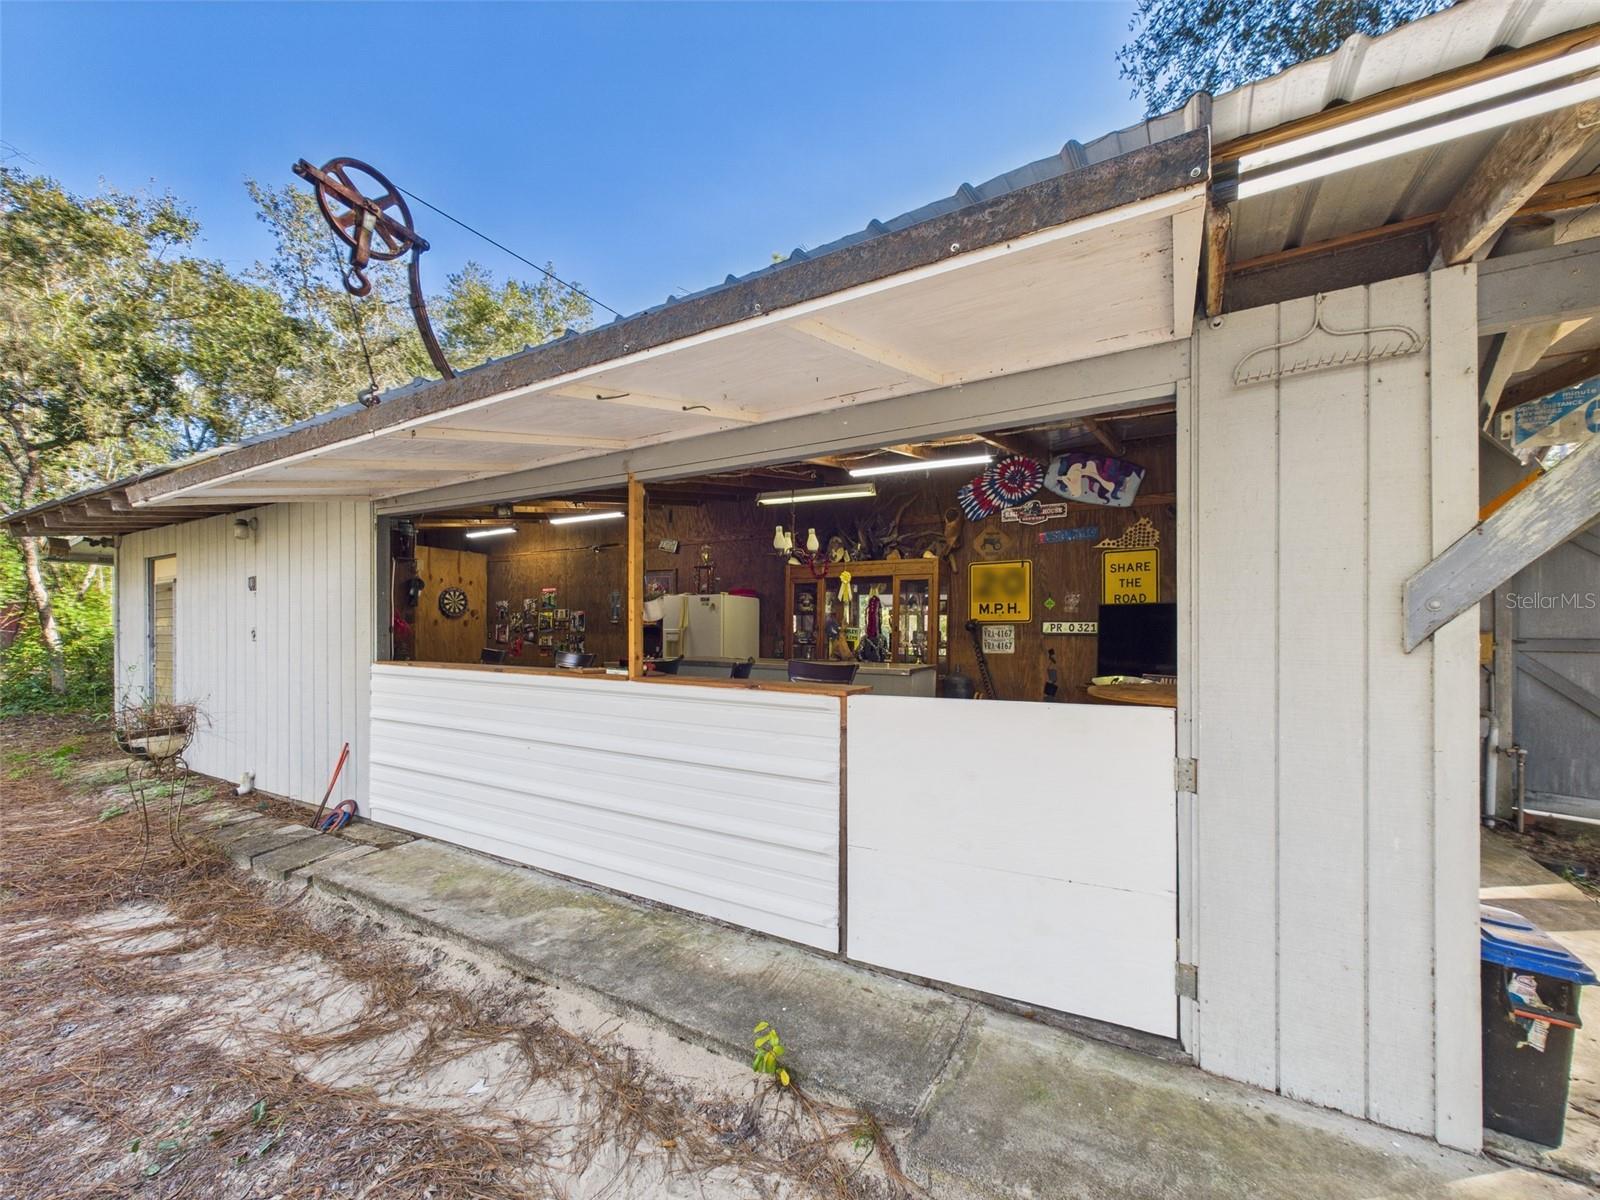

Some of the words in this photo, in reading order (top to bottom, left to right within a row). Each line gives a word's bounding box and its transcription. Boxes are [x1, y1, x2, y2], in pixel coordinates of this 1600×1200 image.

[1563, 388, 1597, 397] minute
[1110, 561, 1151, 573] SHARE
[1119, 577, 1142, 588] THE
[1114, 593, 1147, 604] ROAD
[1050, 623, 1063, 632] PR
